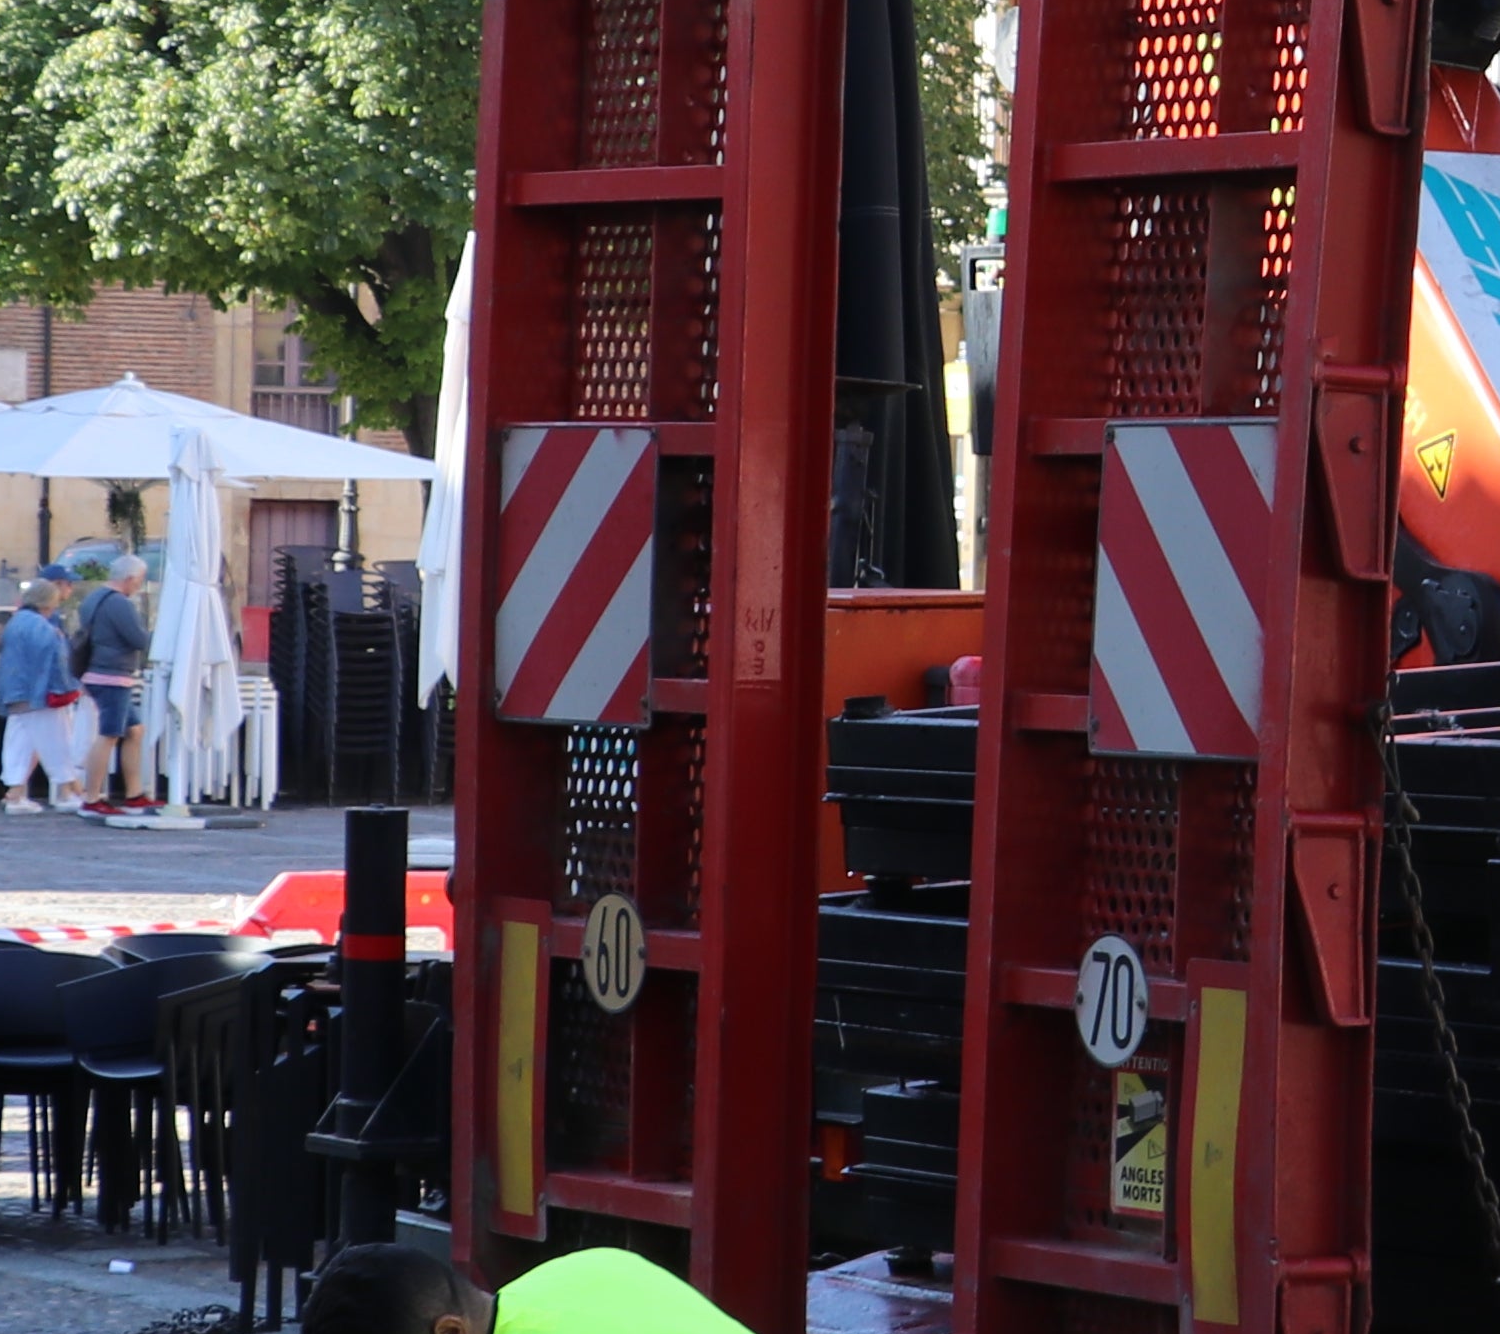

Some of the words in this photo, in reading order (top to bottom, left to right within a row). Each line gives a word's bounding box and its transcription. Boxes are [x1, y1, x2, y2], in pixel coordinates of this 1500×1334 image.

[597, 906, 631, 999] 60
[1090, 950, 1134, 1050] 70
[1120, 1166, 1164, 1185] ANGLES
[1122, 1184, 1162, 1203] MORTS
